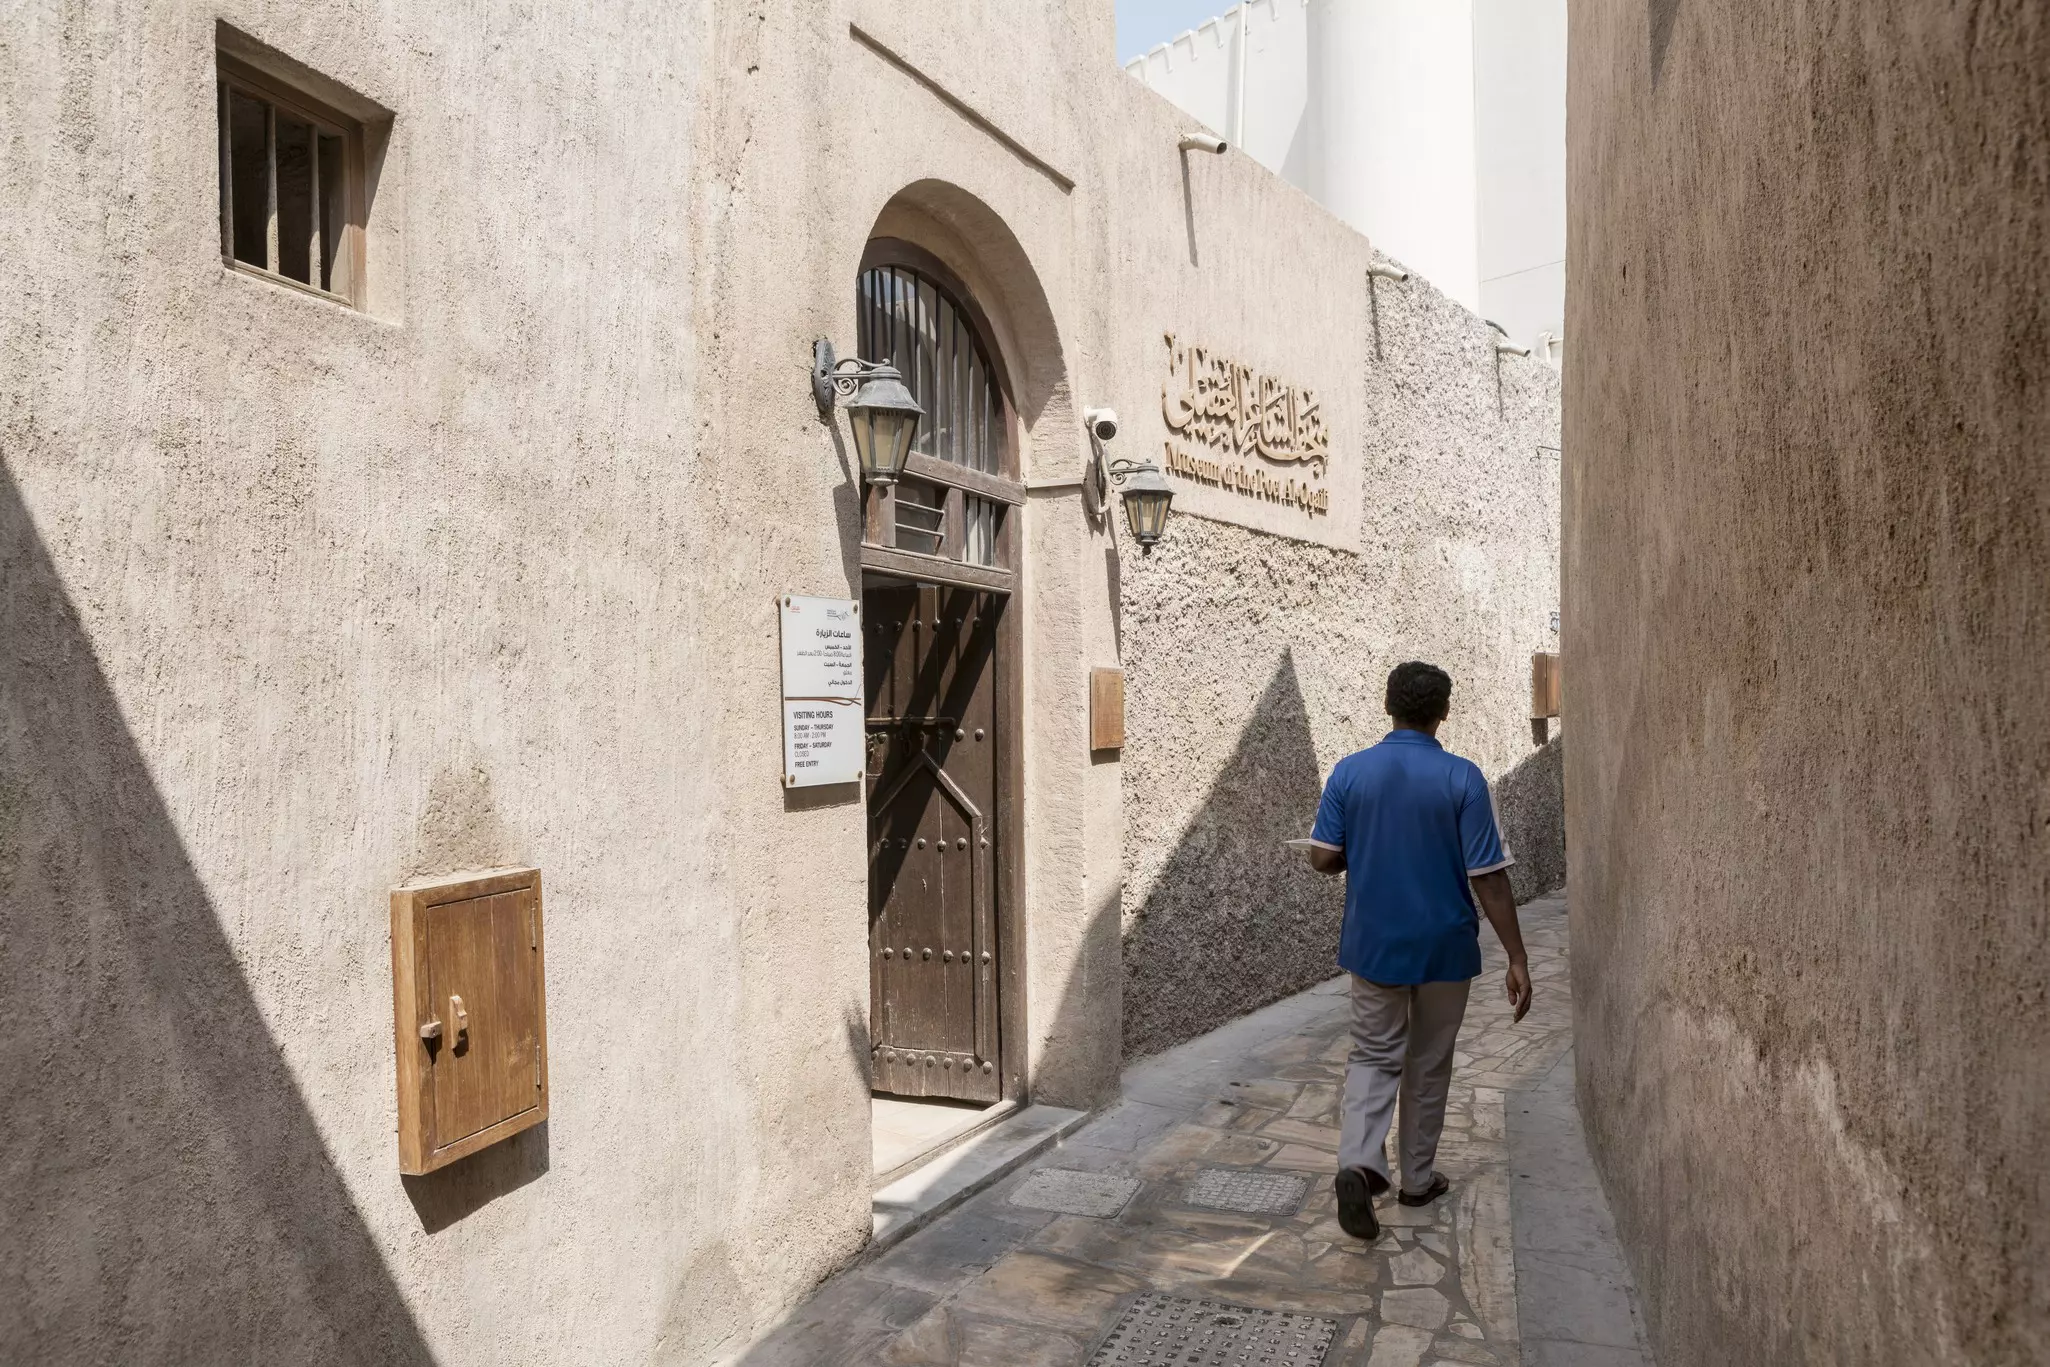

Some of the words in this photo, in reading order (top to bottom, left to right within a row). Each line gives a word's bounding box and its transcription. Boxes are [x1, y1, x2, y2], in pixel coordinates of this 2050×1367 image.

[1164, 442, 1220, 482] Museum
[1236, 465, 1254, 490] the
[1255, 469, 1279, 498] Poet
[815, 628, 832, 639] الزيارة
[833, 630, 852, 638] ساعات
[828, 679, 840, 687] مجاني
[793, 711, 815, 720] VISITING
[816, 710, 833, 719] HOURS
[794, 742, 809, 750] FRIDAY
[812, 741, 832, 749] SATURDAY
[794, 750, 810, 758] CLOSED
[805, 760, 819, 768] ENTRY
